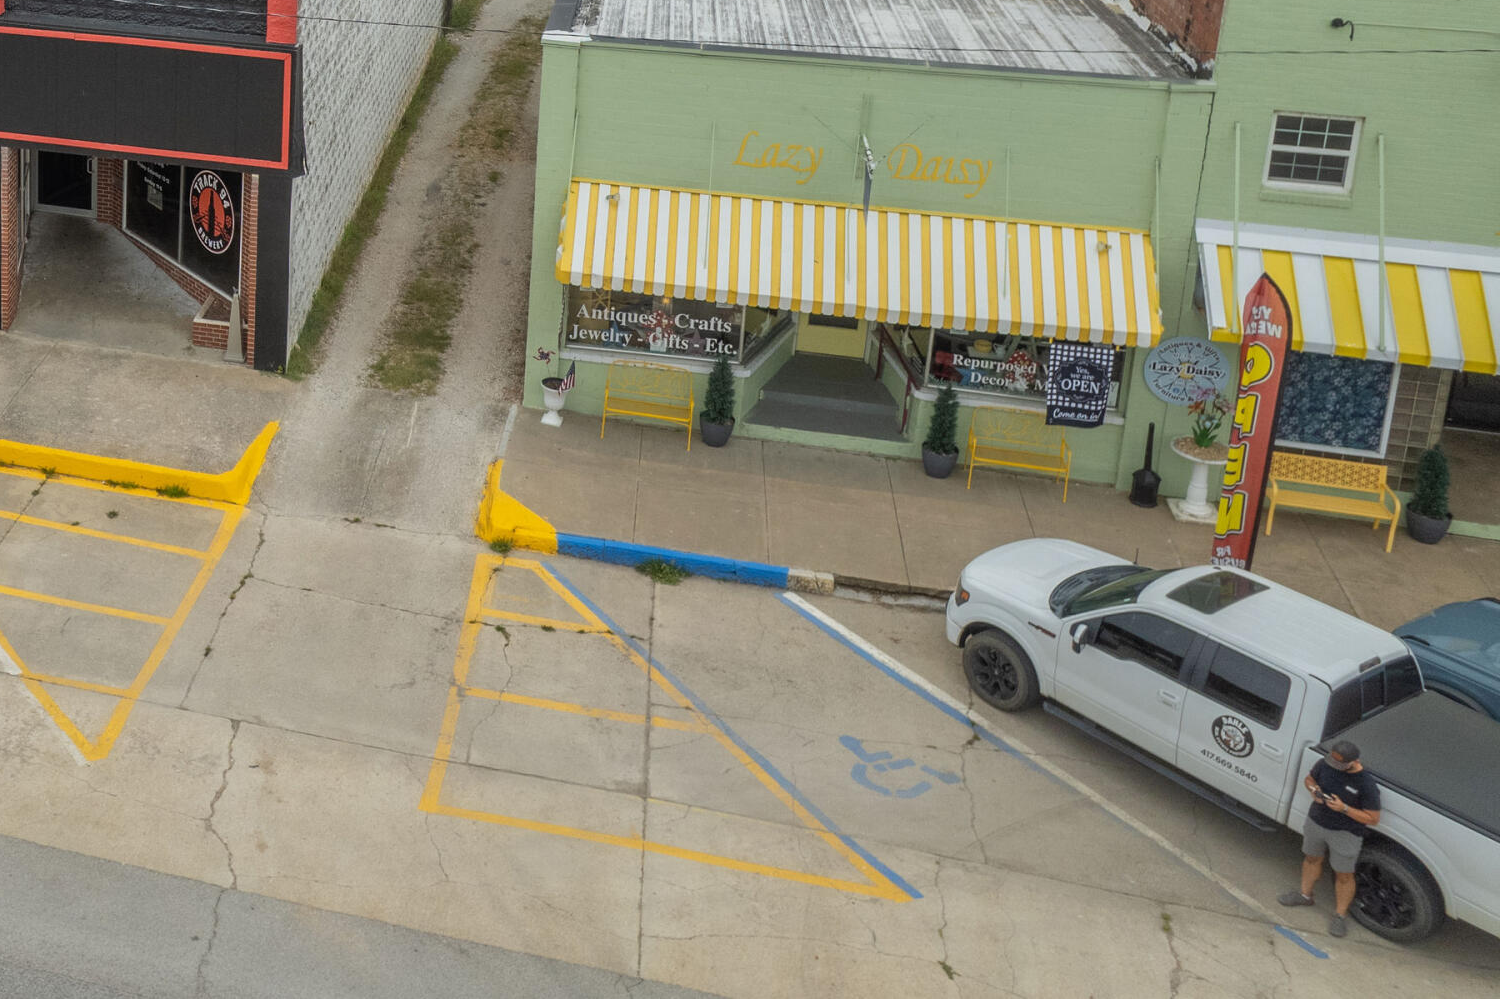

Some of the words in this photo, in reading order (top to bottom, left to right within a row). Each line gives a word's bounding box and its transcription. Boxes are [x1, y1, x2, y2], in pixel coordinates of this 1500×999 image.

[732, 130, 824, 185] Lazy
[887, 143, 992, 199] Daisy
[194, 174, 219, 194] TRACK
[220, 188, 230, 209] 94
[198, 226, 224, 250] BREWERY
[577, 303, 658, 327] Antiques
[674, 313, 733, 333] Crafts
[569, 324, 633, 346] Jewelry
[648, 332, 689, 350] Gifts
[706, 337, 738, 355] Etc.
[1159, 341, 1193, 354] Antiques
[952, 353, 1037, 374] Repurposed
[1152, 361, 1182, 375] Lazy
[1186, 365, 1224, 379] Daisy
[970, 371, 1013, 388] Decor
[1061, 378, 1101, 394] OPEN
[1053, 407, 1075, 419] Come
[1076, 412, 1088, 420] on
[1200, 748, 1258, 783] 417.669.5840
